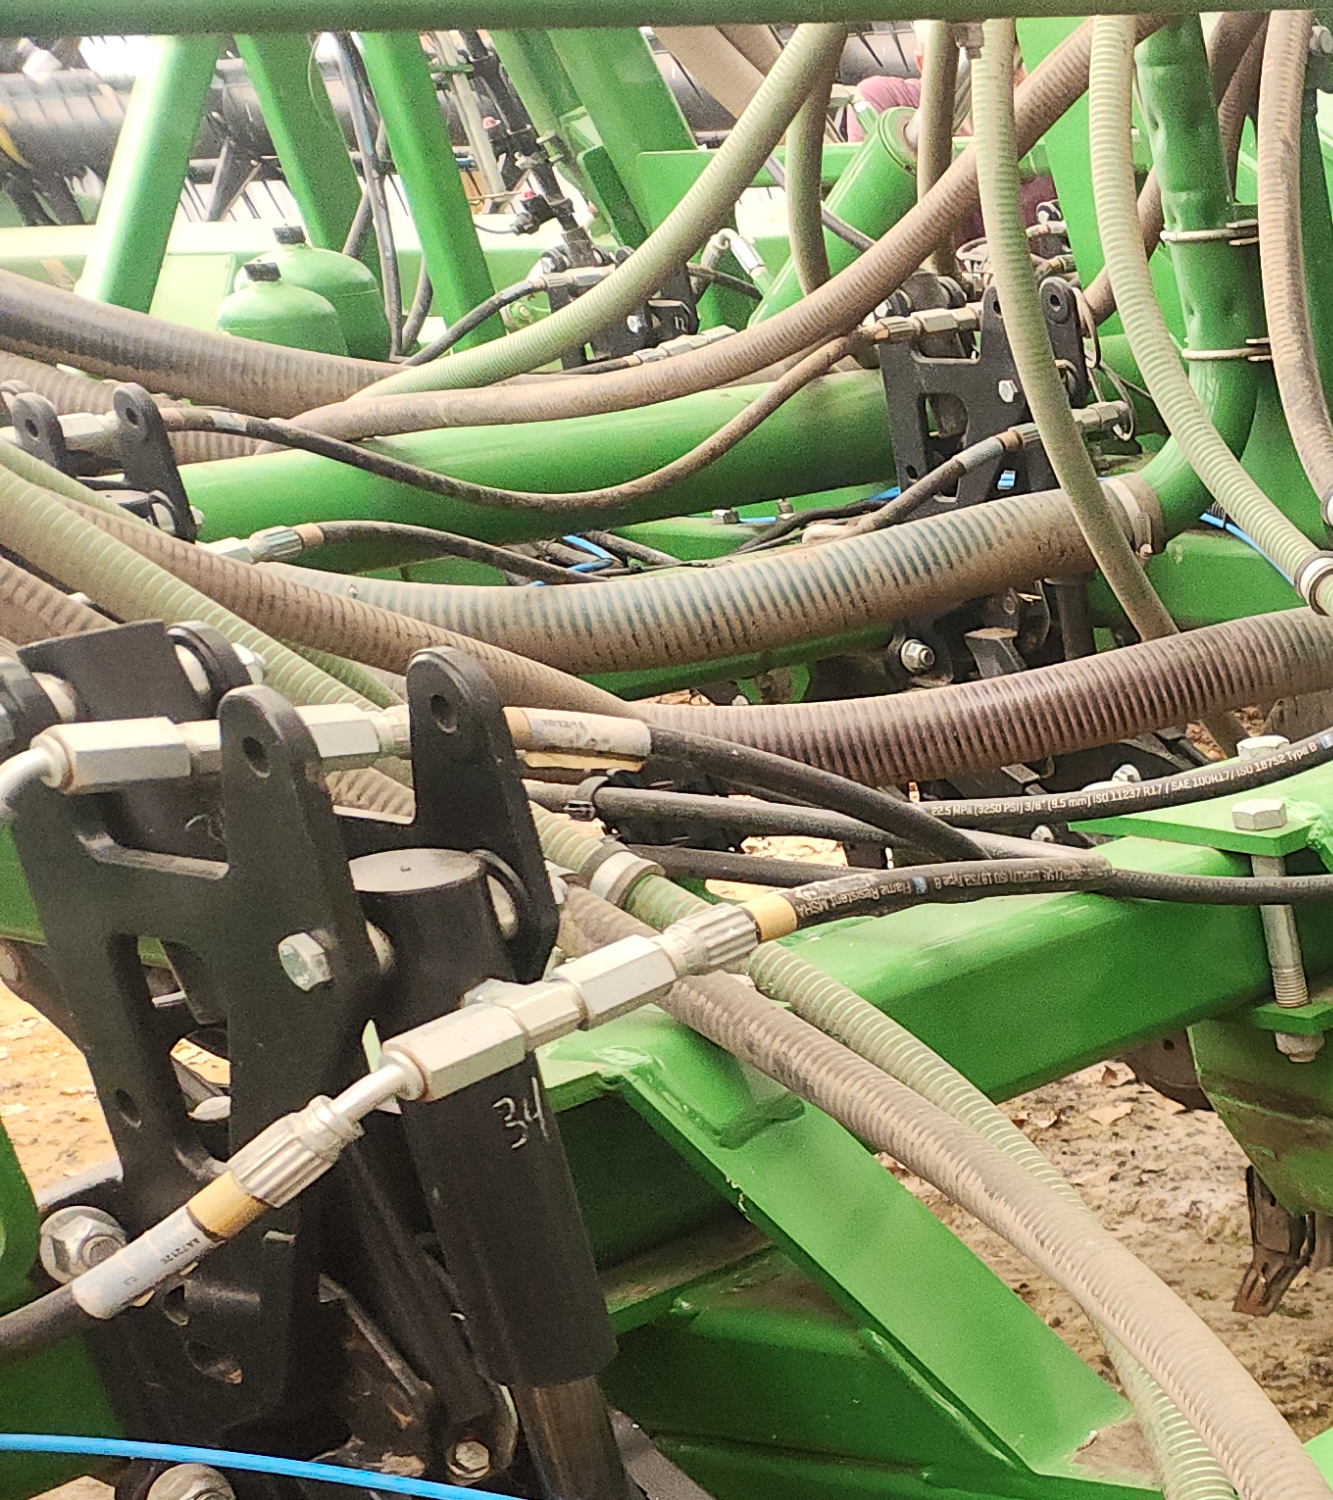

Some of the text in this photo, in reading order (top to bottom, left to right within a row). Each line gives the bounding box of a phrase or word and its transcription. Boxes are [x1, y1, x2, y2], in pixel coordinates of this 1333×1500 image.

[1093, 791, 1109, 804] ISO
[1110, 787, 1142, 803] 11237
[1143, 782, 1163, 798] R17
[1170, 778, 1193, 793] SAE
[1236, 764, 1254, 779] ISO
[1254, 753, 1287, 775] 18752
[1287, 746, 1309, 763] Type
[1309, 741, 1318, 753] B
[880, 879, 912, 896] Flame
[796, 897, 832, 919] MSHA
